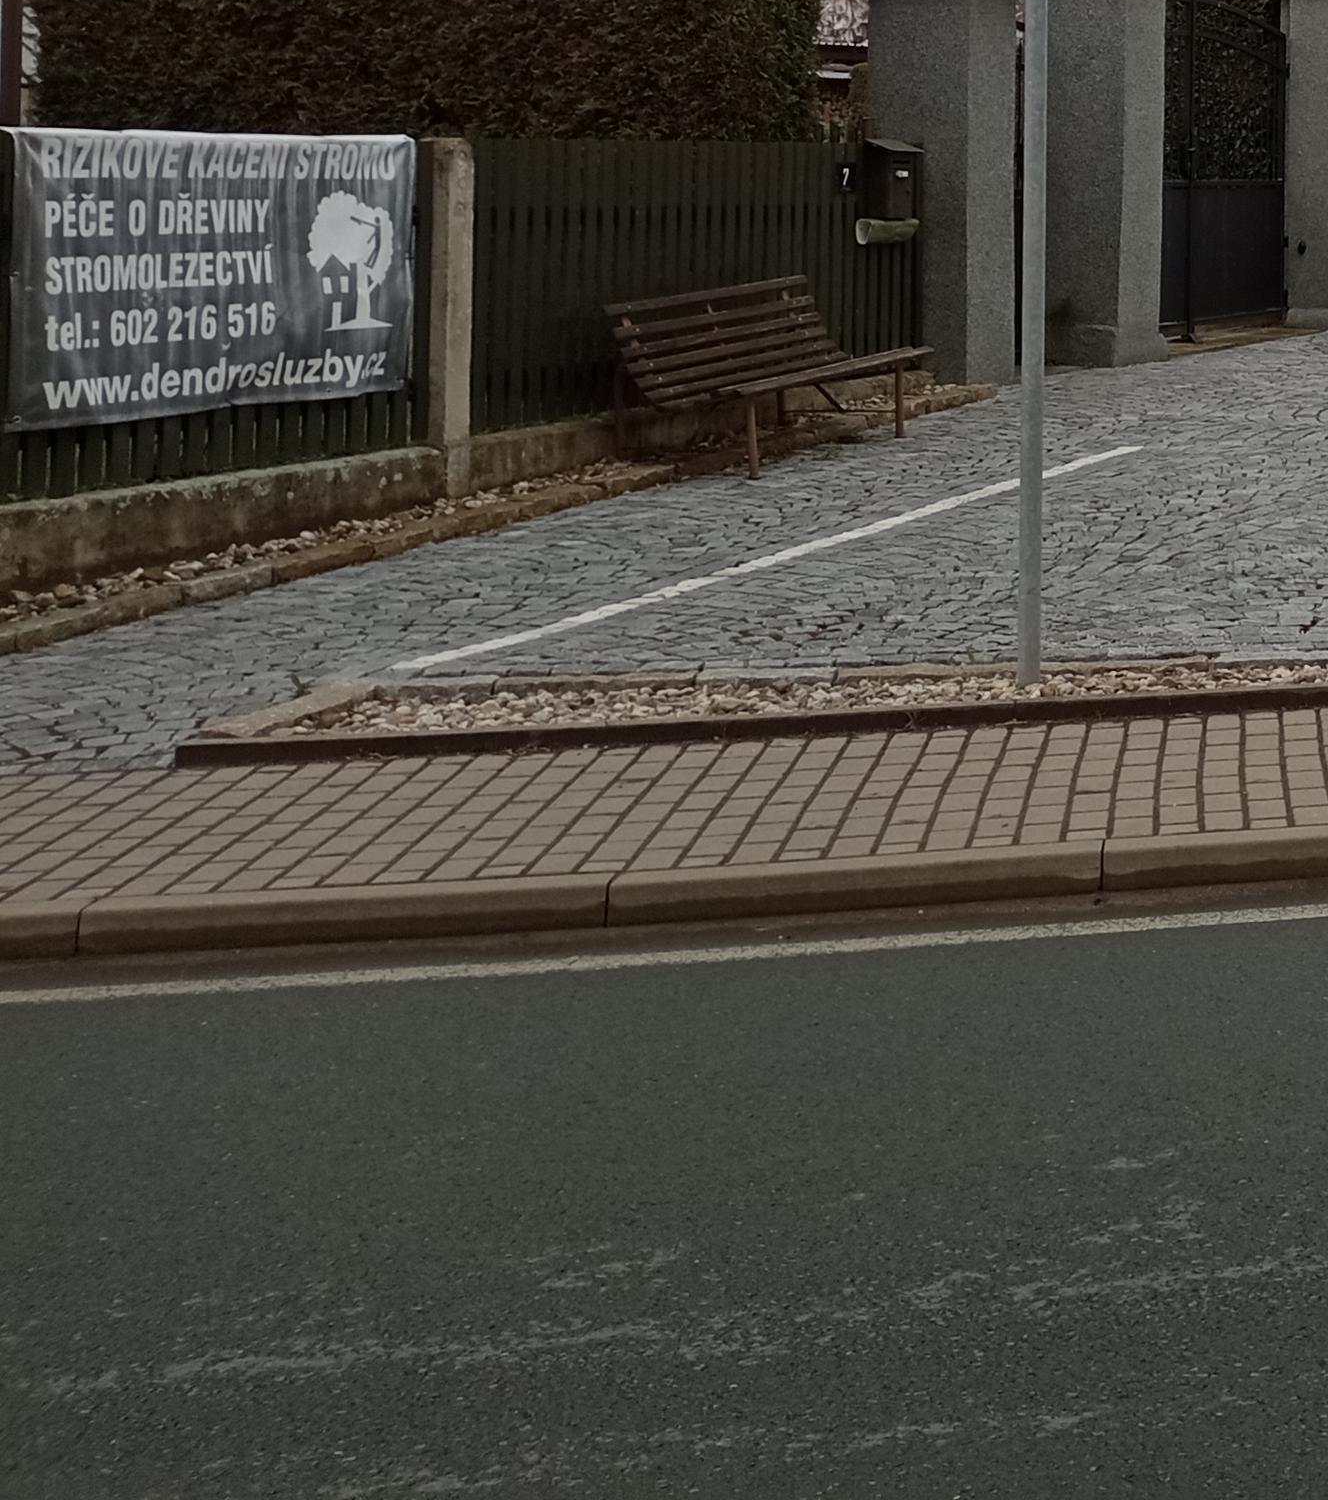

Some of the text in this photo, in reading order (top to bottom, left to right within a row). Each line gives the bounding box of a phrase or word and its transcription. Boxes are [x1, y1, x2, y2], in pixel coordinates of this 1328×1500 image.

[842, 167, 850, 186] 7
[44, 193, 270, 238] PÉČE O DŘEVINY
[44, 243, 274, 295] STROMOLEZECTVÍ
[44, 301, 276, 352] tel.: 602 216 516
[42, 347, 387, 410] www.dendrosluzby.cz
